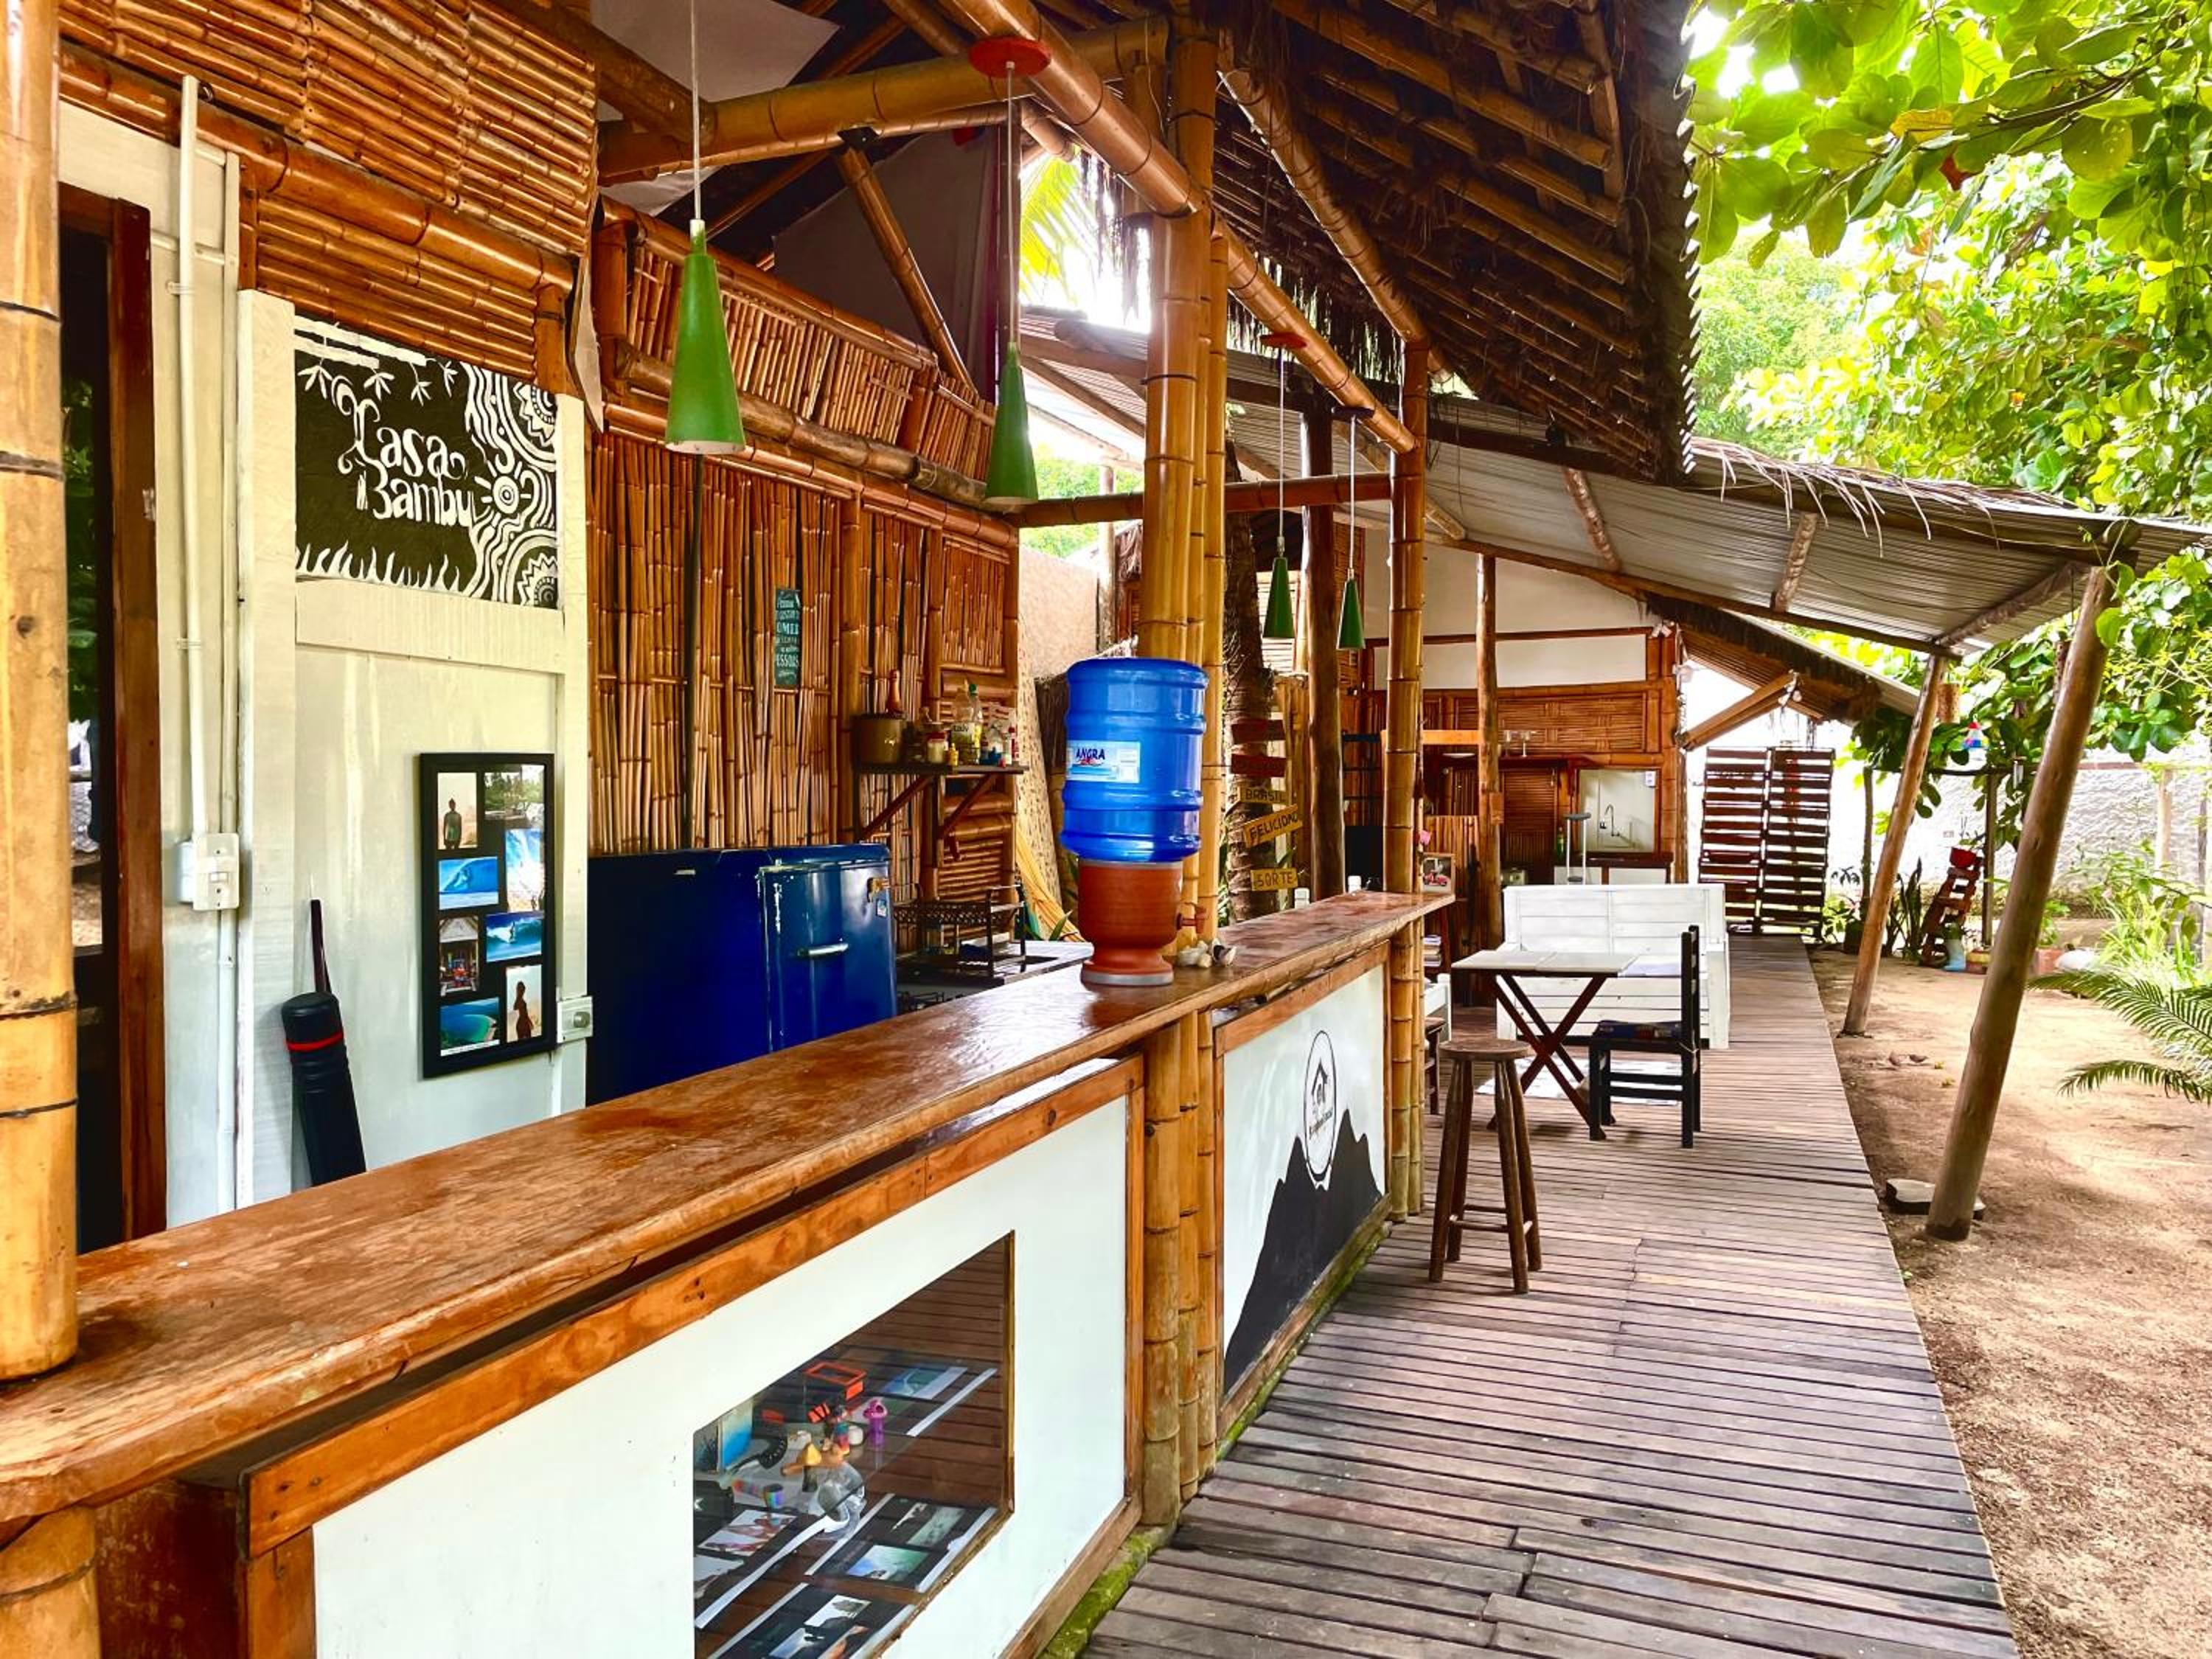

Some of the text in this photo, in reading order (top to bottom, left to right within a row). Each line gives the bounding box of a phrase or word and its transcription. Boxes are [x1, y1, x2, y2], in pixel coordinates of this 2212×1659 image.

[331, 375, 468, 480] Casa
[355, 465, 475, 528] Bambu
[1076, 748, 1105, 760] ANGRA
[1246, 789, 1286, 802] BRASIL
[1257, 872, 1293, 887] SORTE
